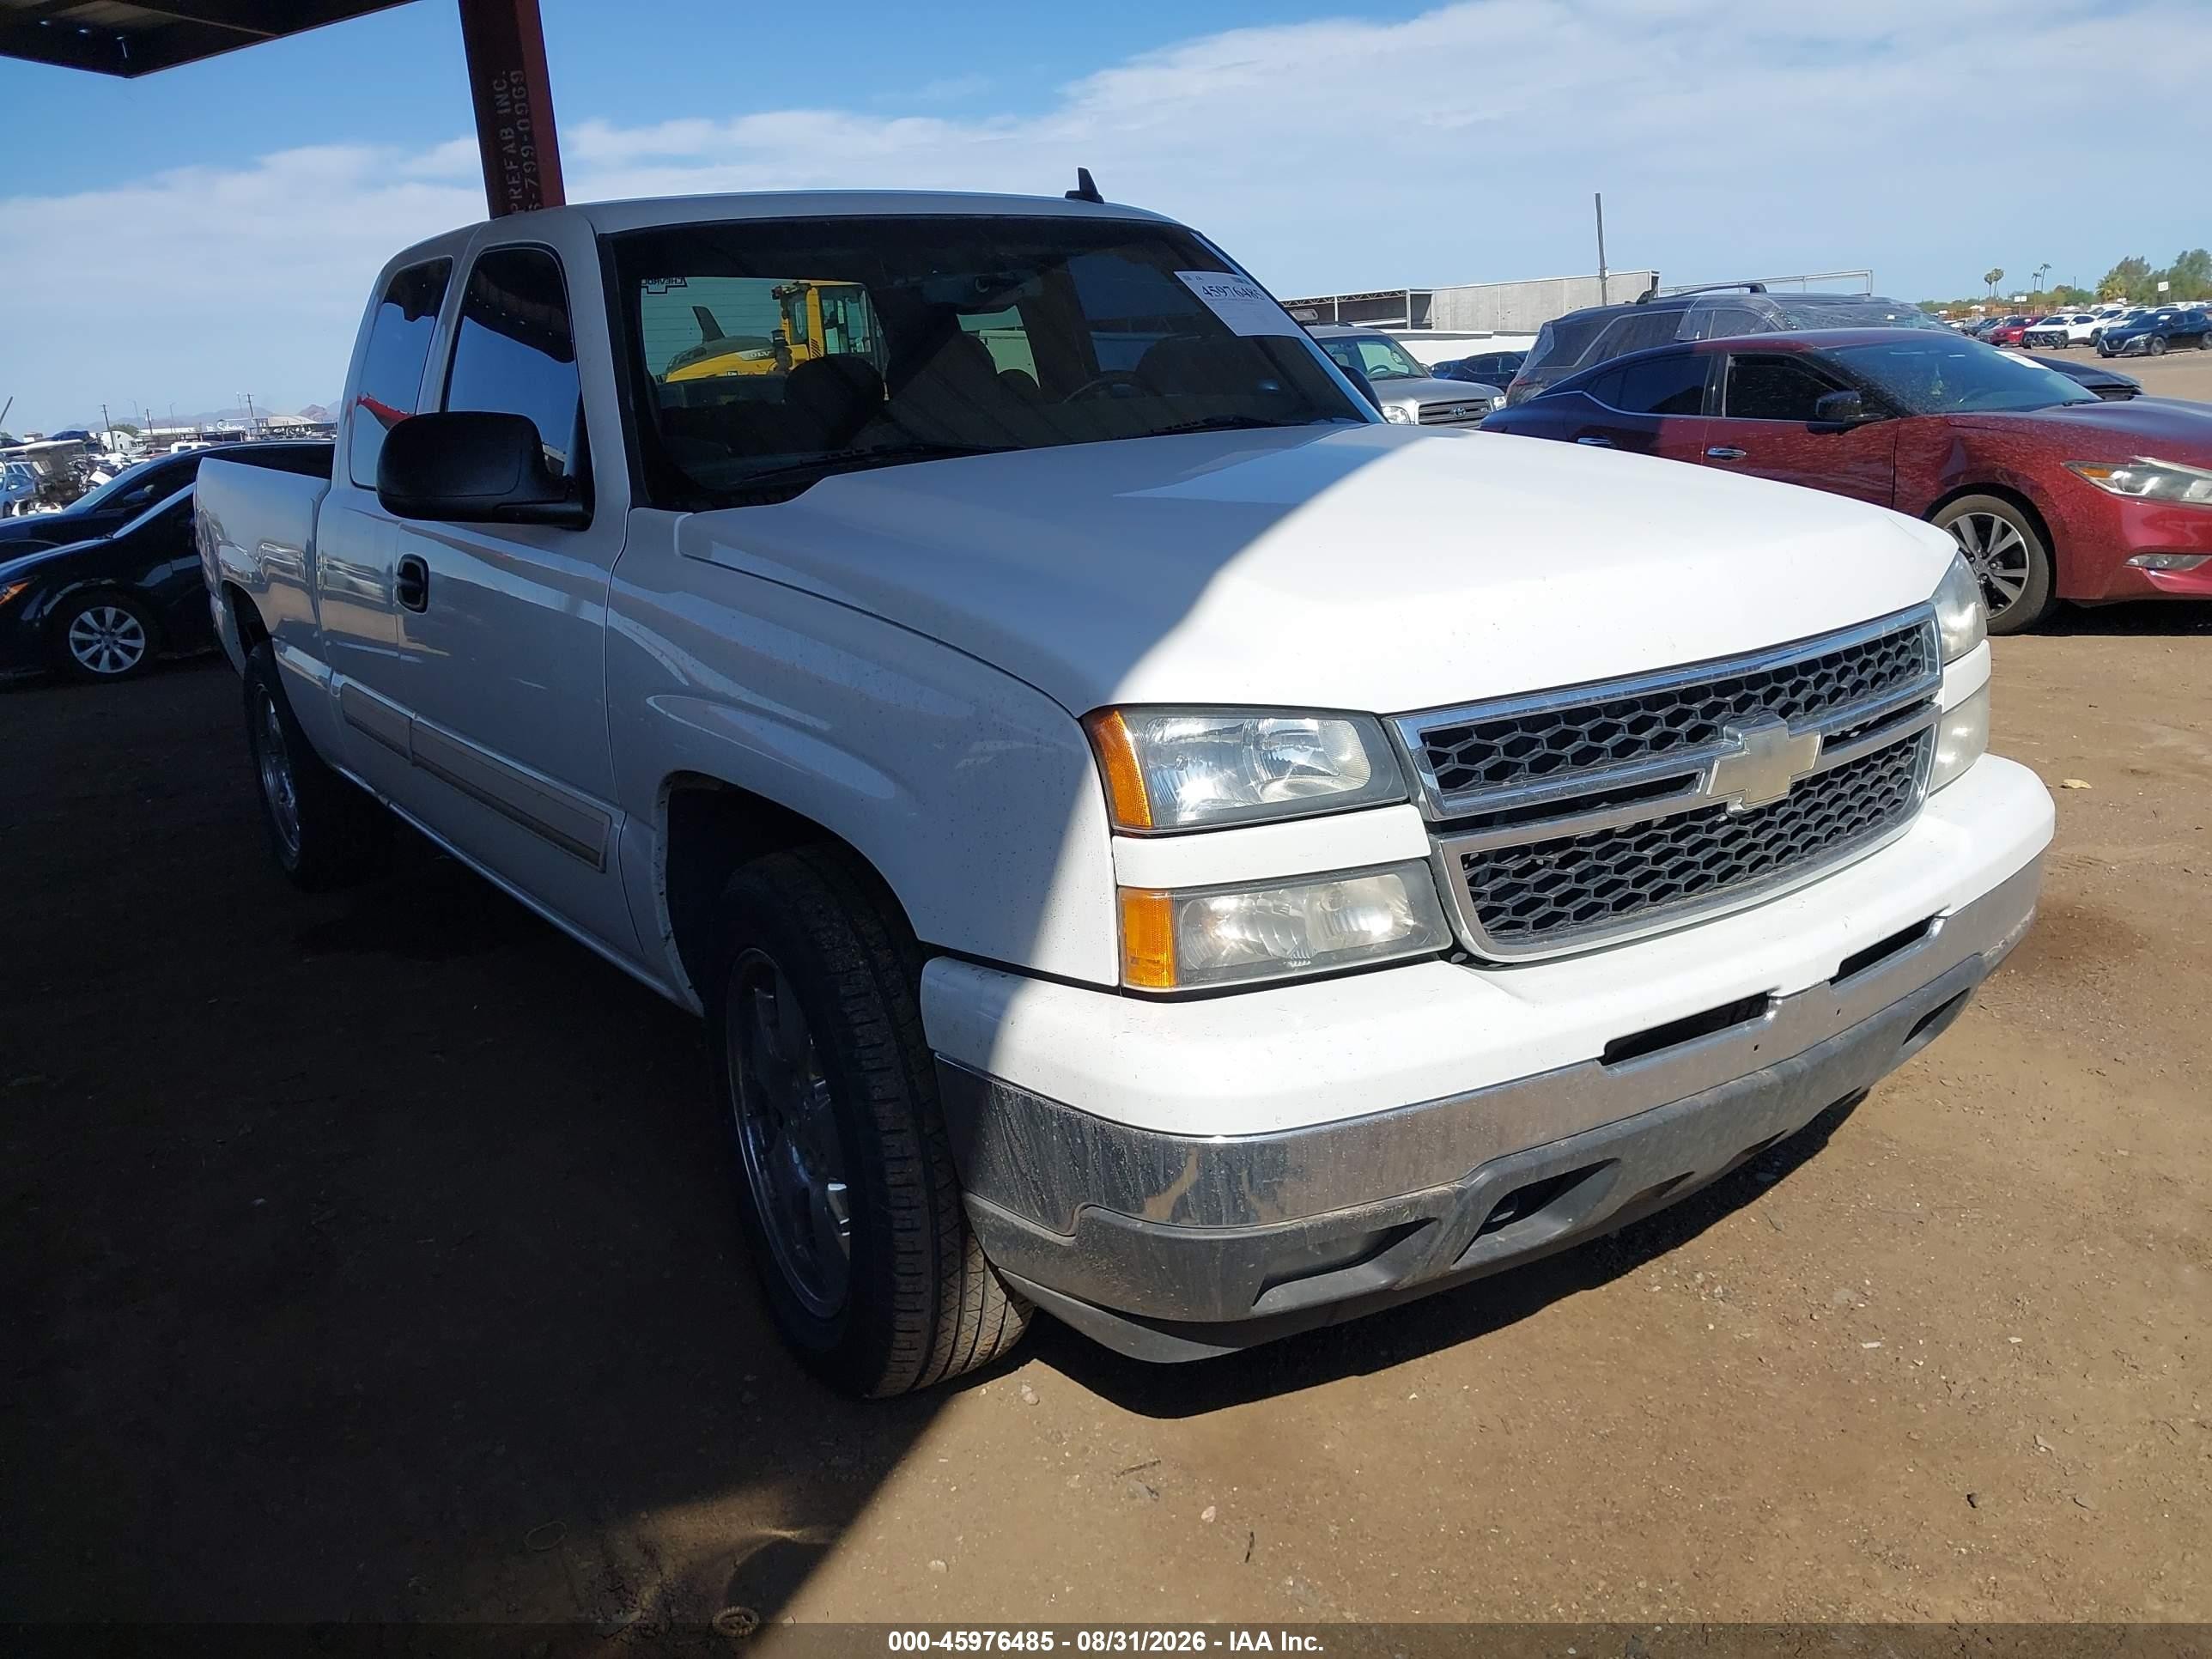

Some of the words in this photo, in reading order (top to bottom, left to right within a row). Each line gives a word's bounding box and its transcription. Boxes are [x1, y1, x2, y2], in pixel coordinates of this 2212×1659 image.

[493, 70, 512, 115] INC.
[500, 127, 524, 215] PREFAB
[1201, 285, 1265, 301] 45976485
